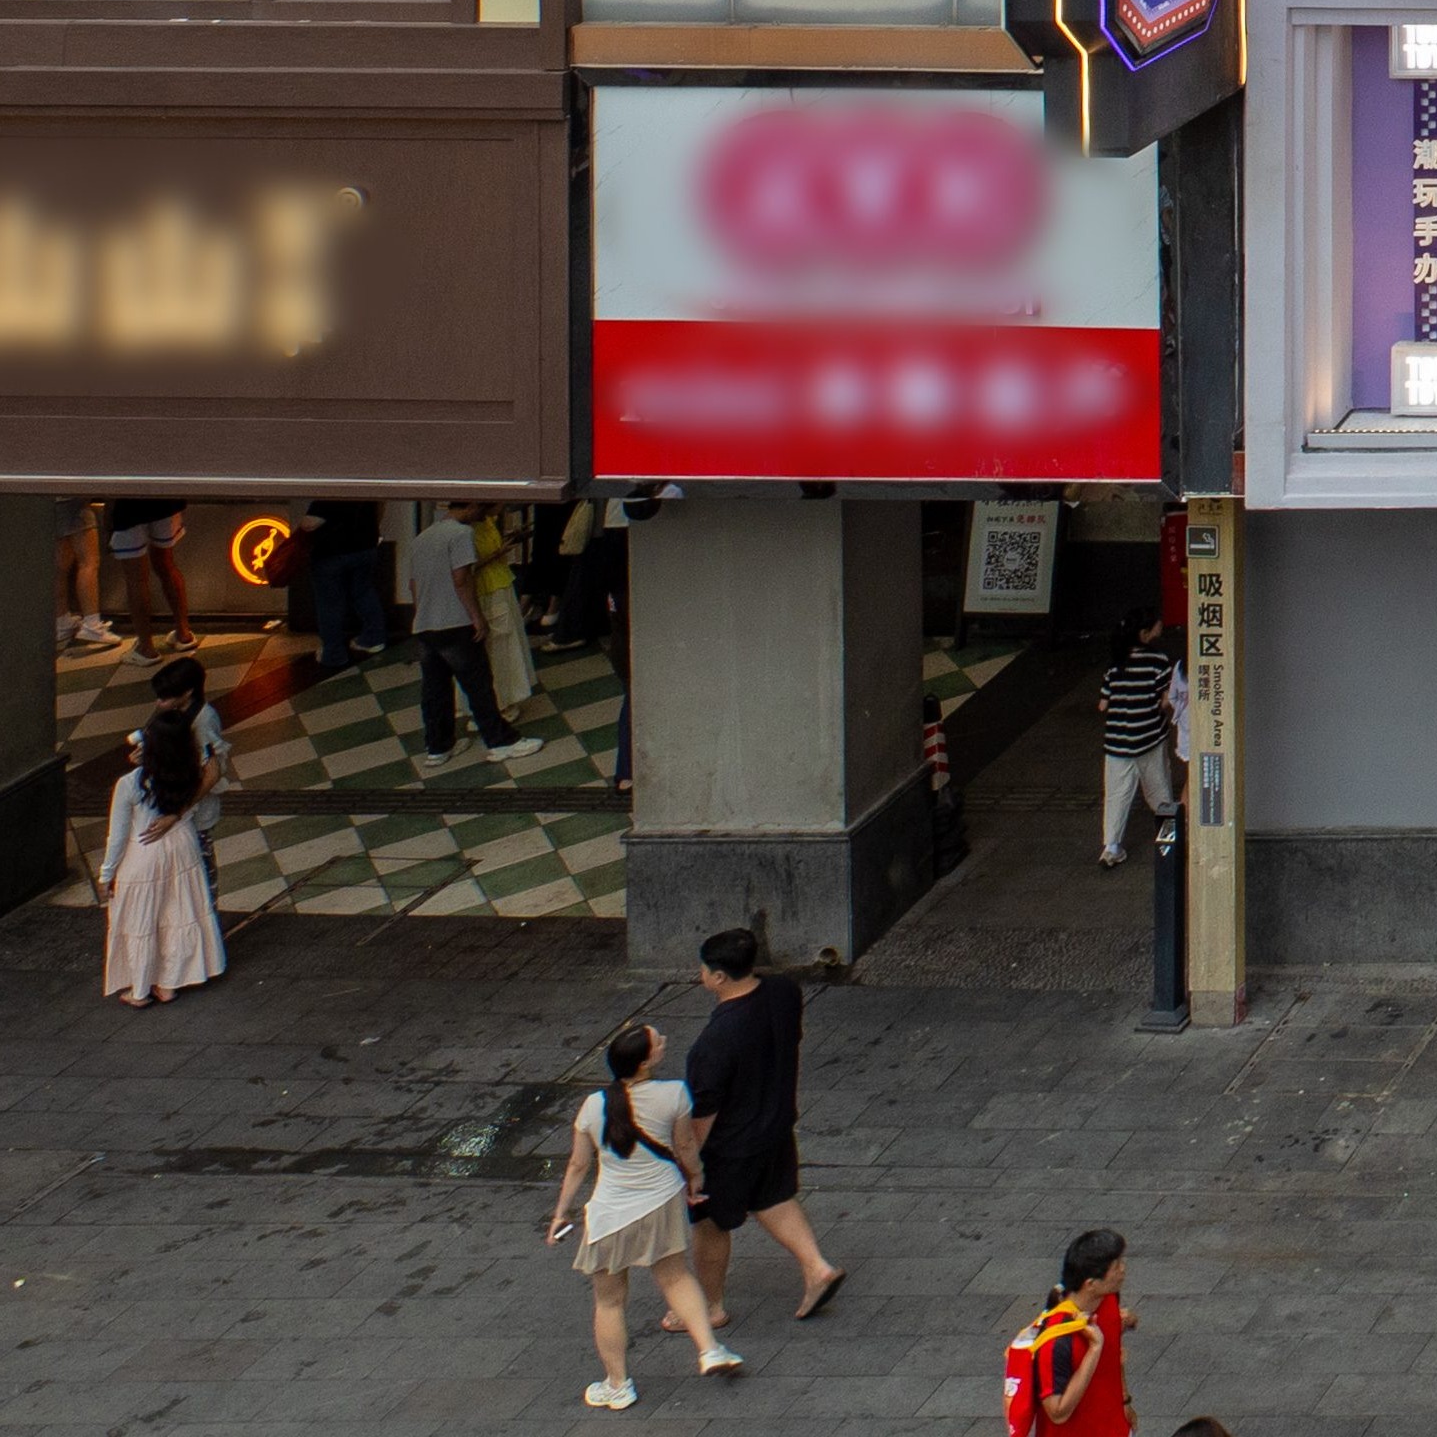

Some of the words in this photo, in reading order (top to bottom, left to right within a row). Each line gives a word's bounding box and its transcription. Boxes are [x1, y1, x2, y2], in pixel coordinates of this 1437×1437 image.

[1198, 573, 1224, 657] 吸烟区
[1213, 664, 1224, 716] Smoking
[1214, 720, 1223, 747] Area
